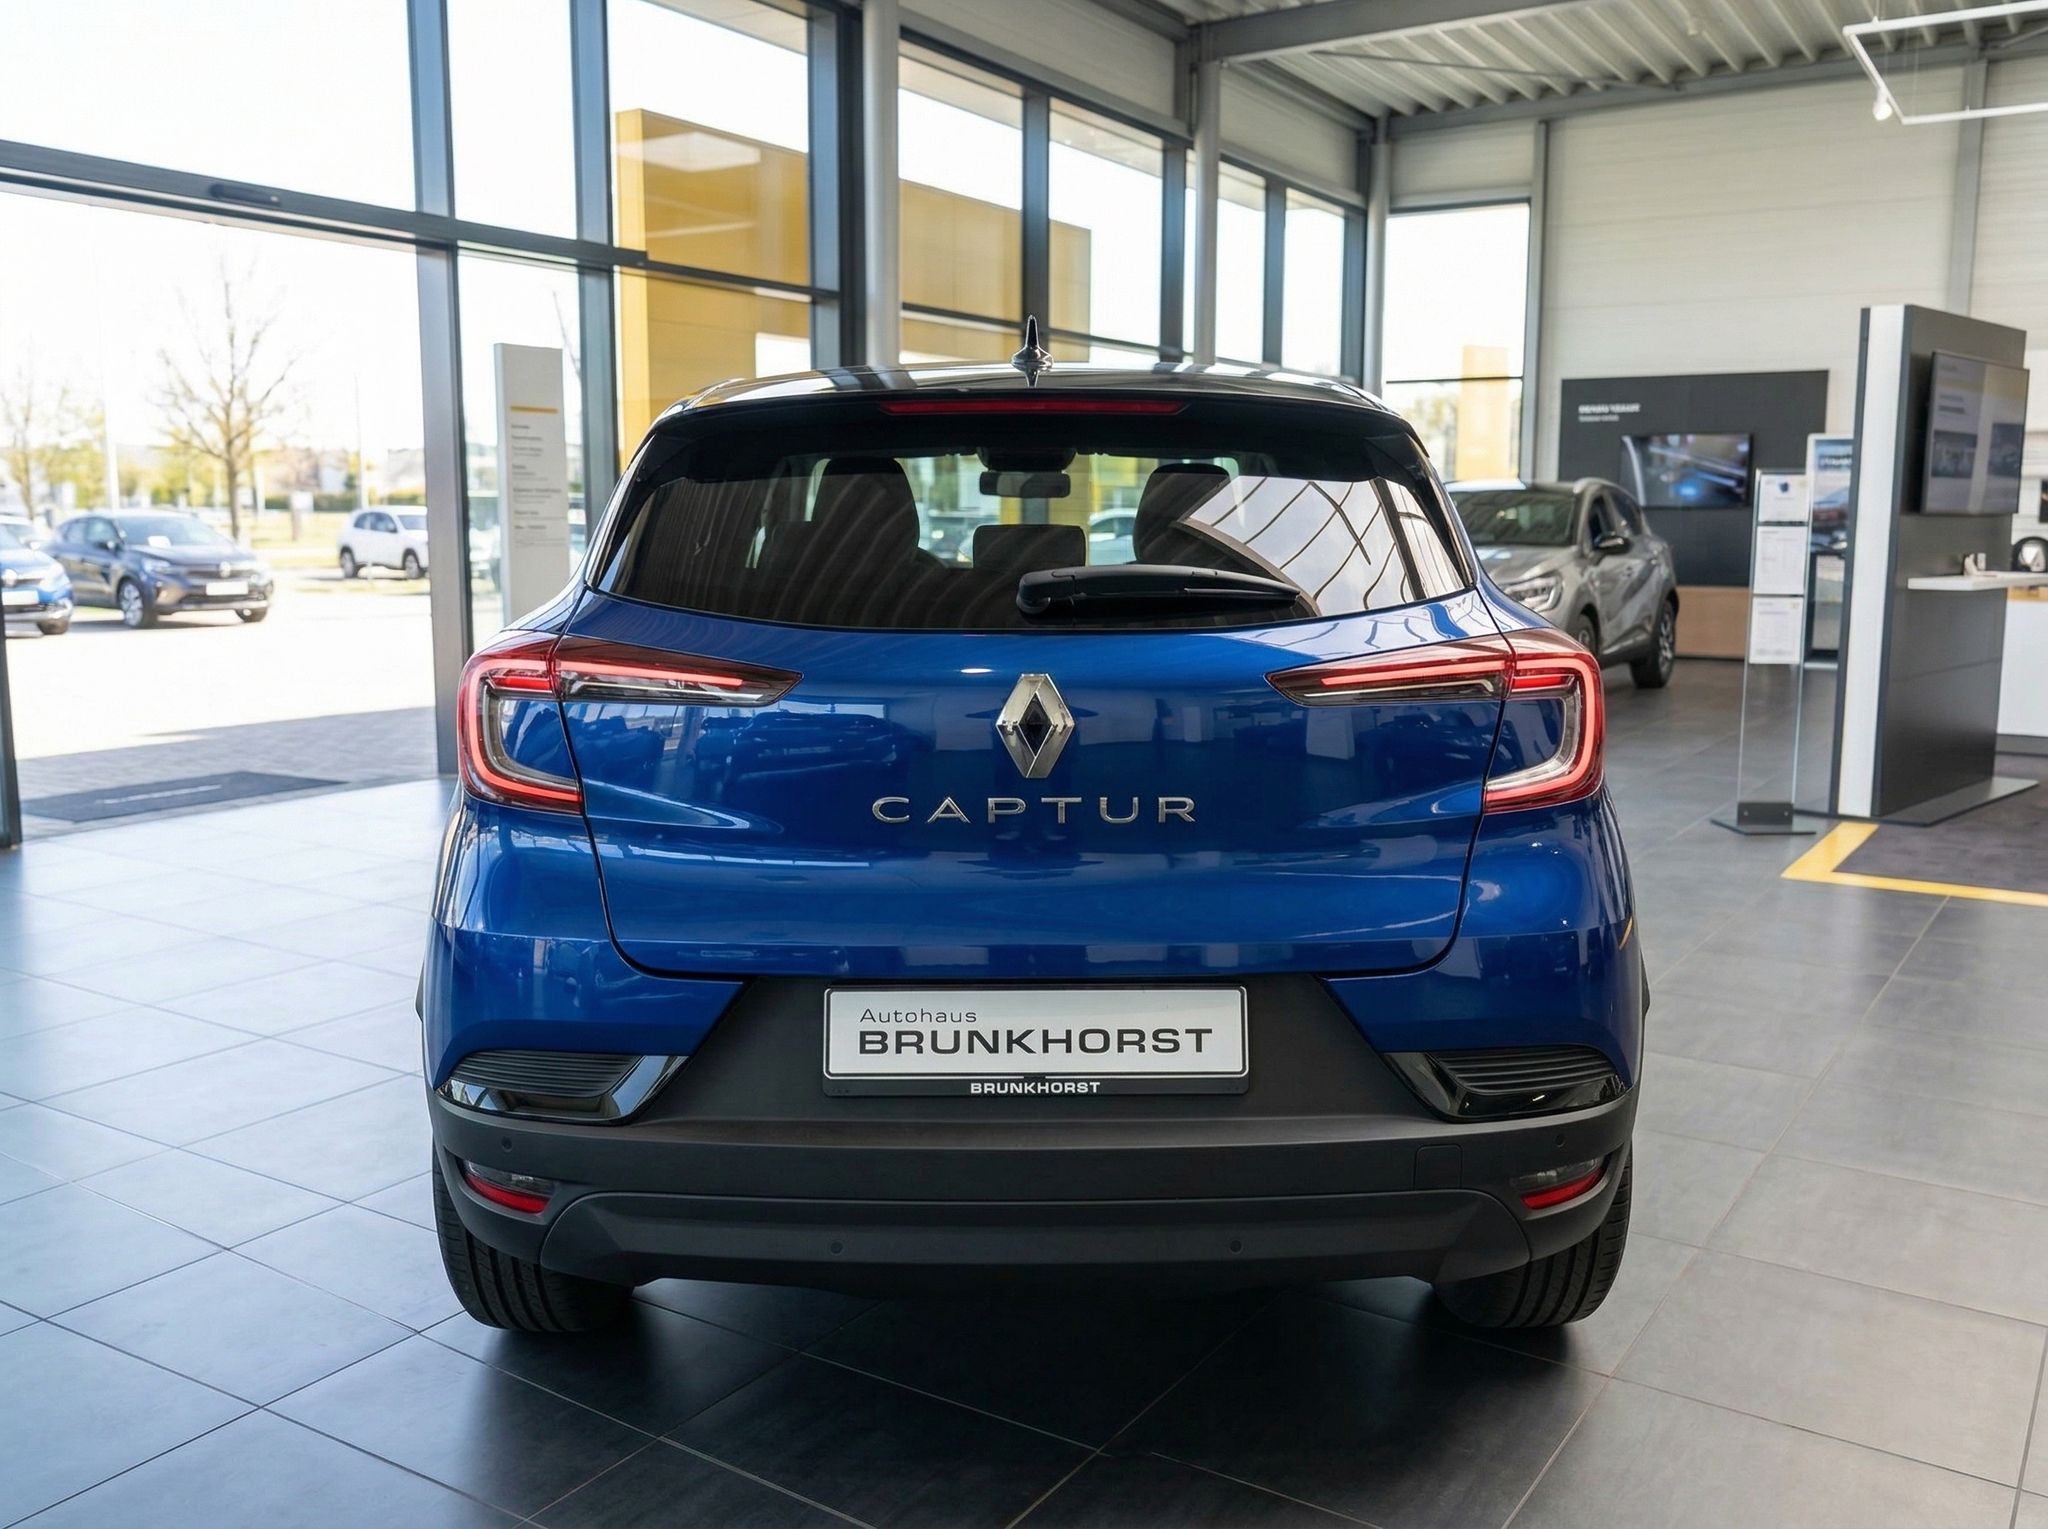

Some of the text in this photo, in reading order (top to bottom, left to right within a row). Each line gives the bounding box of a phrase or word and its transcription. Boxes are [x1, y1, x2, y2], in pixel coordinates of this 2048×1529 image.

[872, 796, 1196, 824] CAPTUR
[859, 1008, 977, 1024] Autohaus
[859, 1028, 1213, 1055] BRUNKHORST
[970, 1081, 1101, 1095] BRUNKHORST
